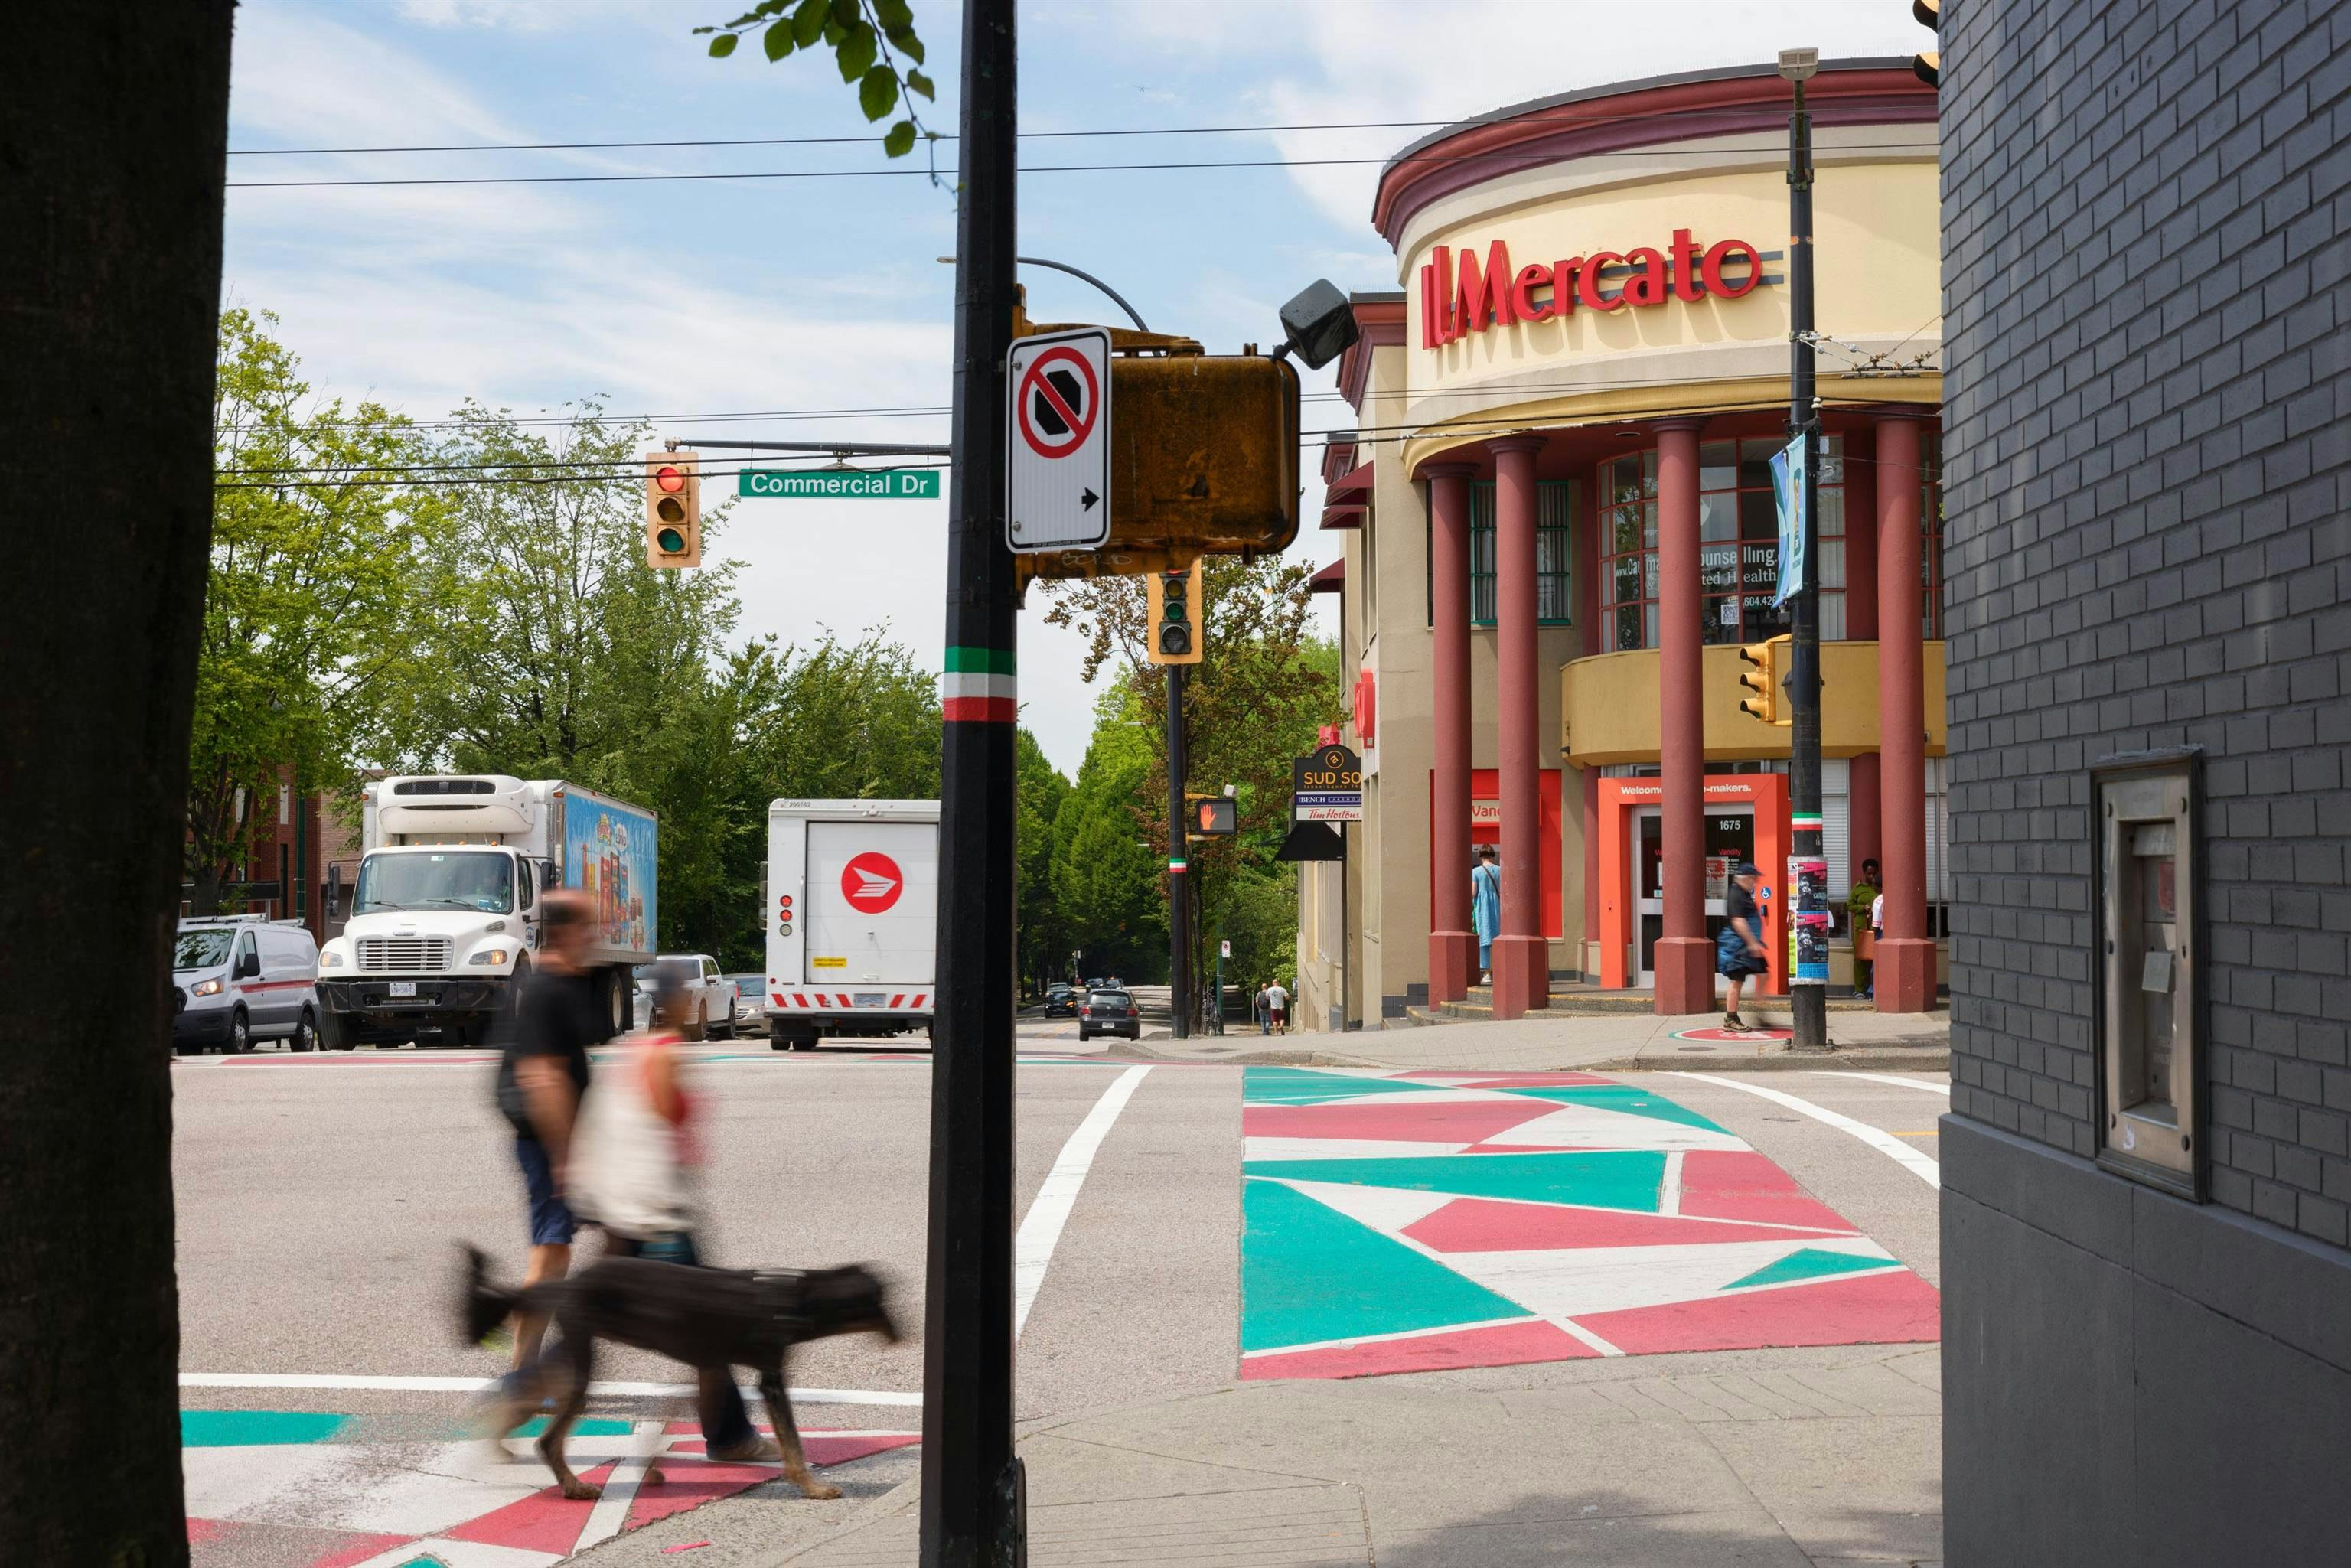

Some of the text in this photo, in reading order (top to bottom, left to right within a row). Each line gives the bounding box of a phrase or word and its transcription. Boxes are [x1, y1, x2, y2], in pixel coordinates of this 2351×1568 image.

[1452, 228, 1762, 338] Mercato
[750, 474, 928, 494] Commercial Dr
[1304, 771, 1335, 784] SUD
[1309, 808, 1360, 819] Tim Hortons
[1719, 820, 1741, 830] 1675
[1718, 847, 1742, 856] Vancity
